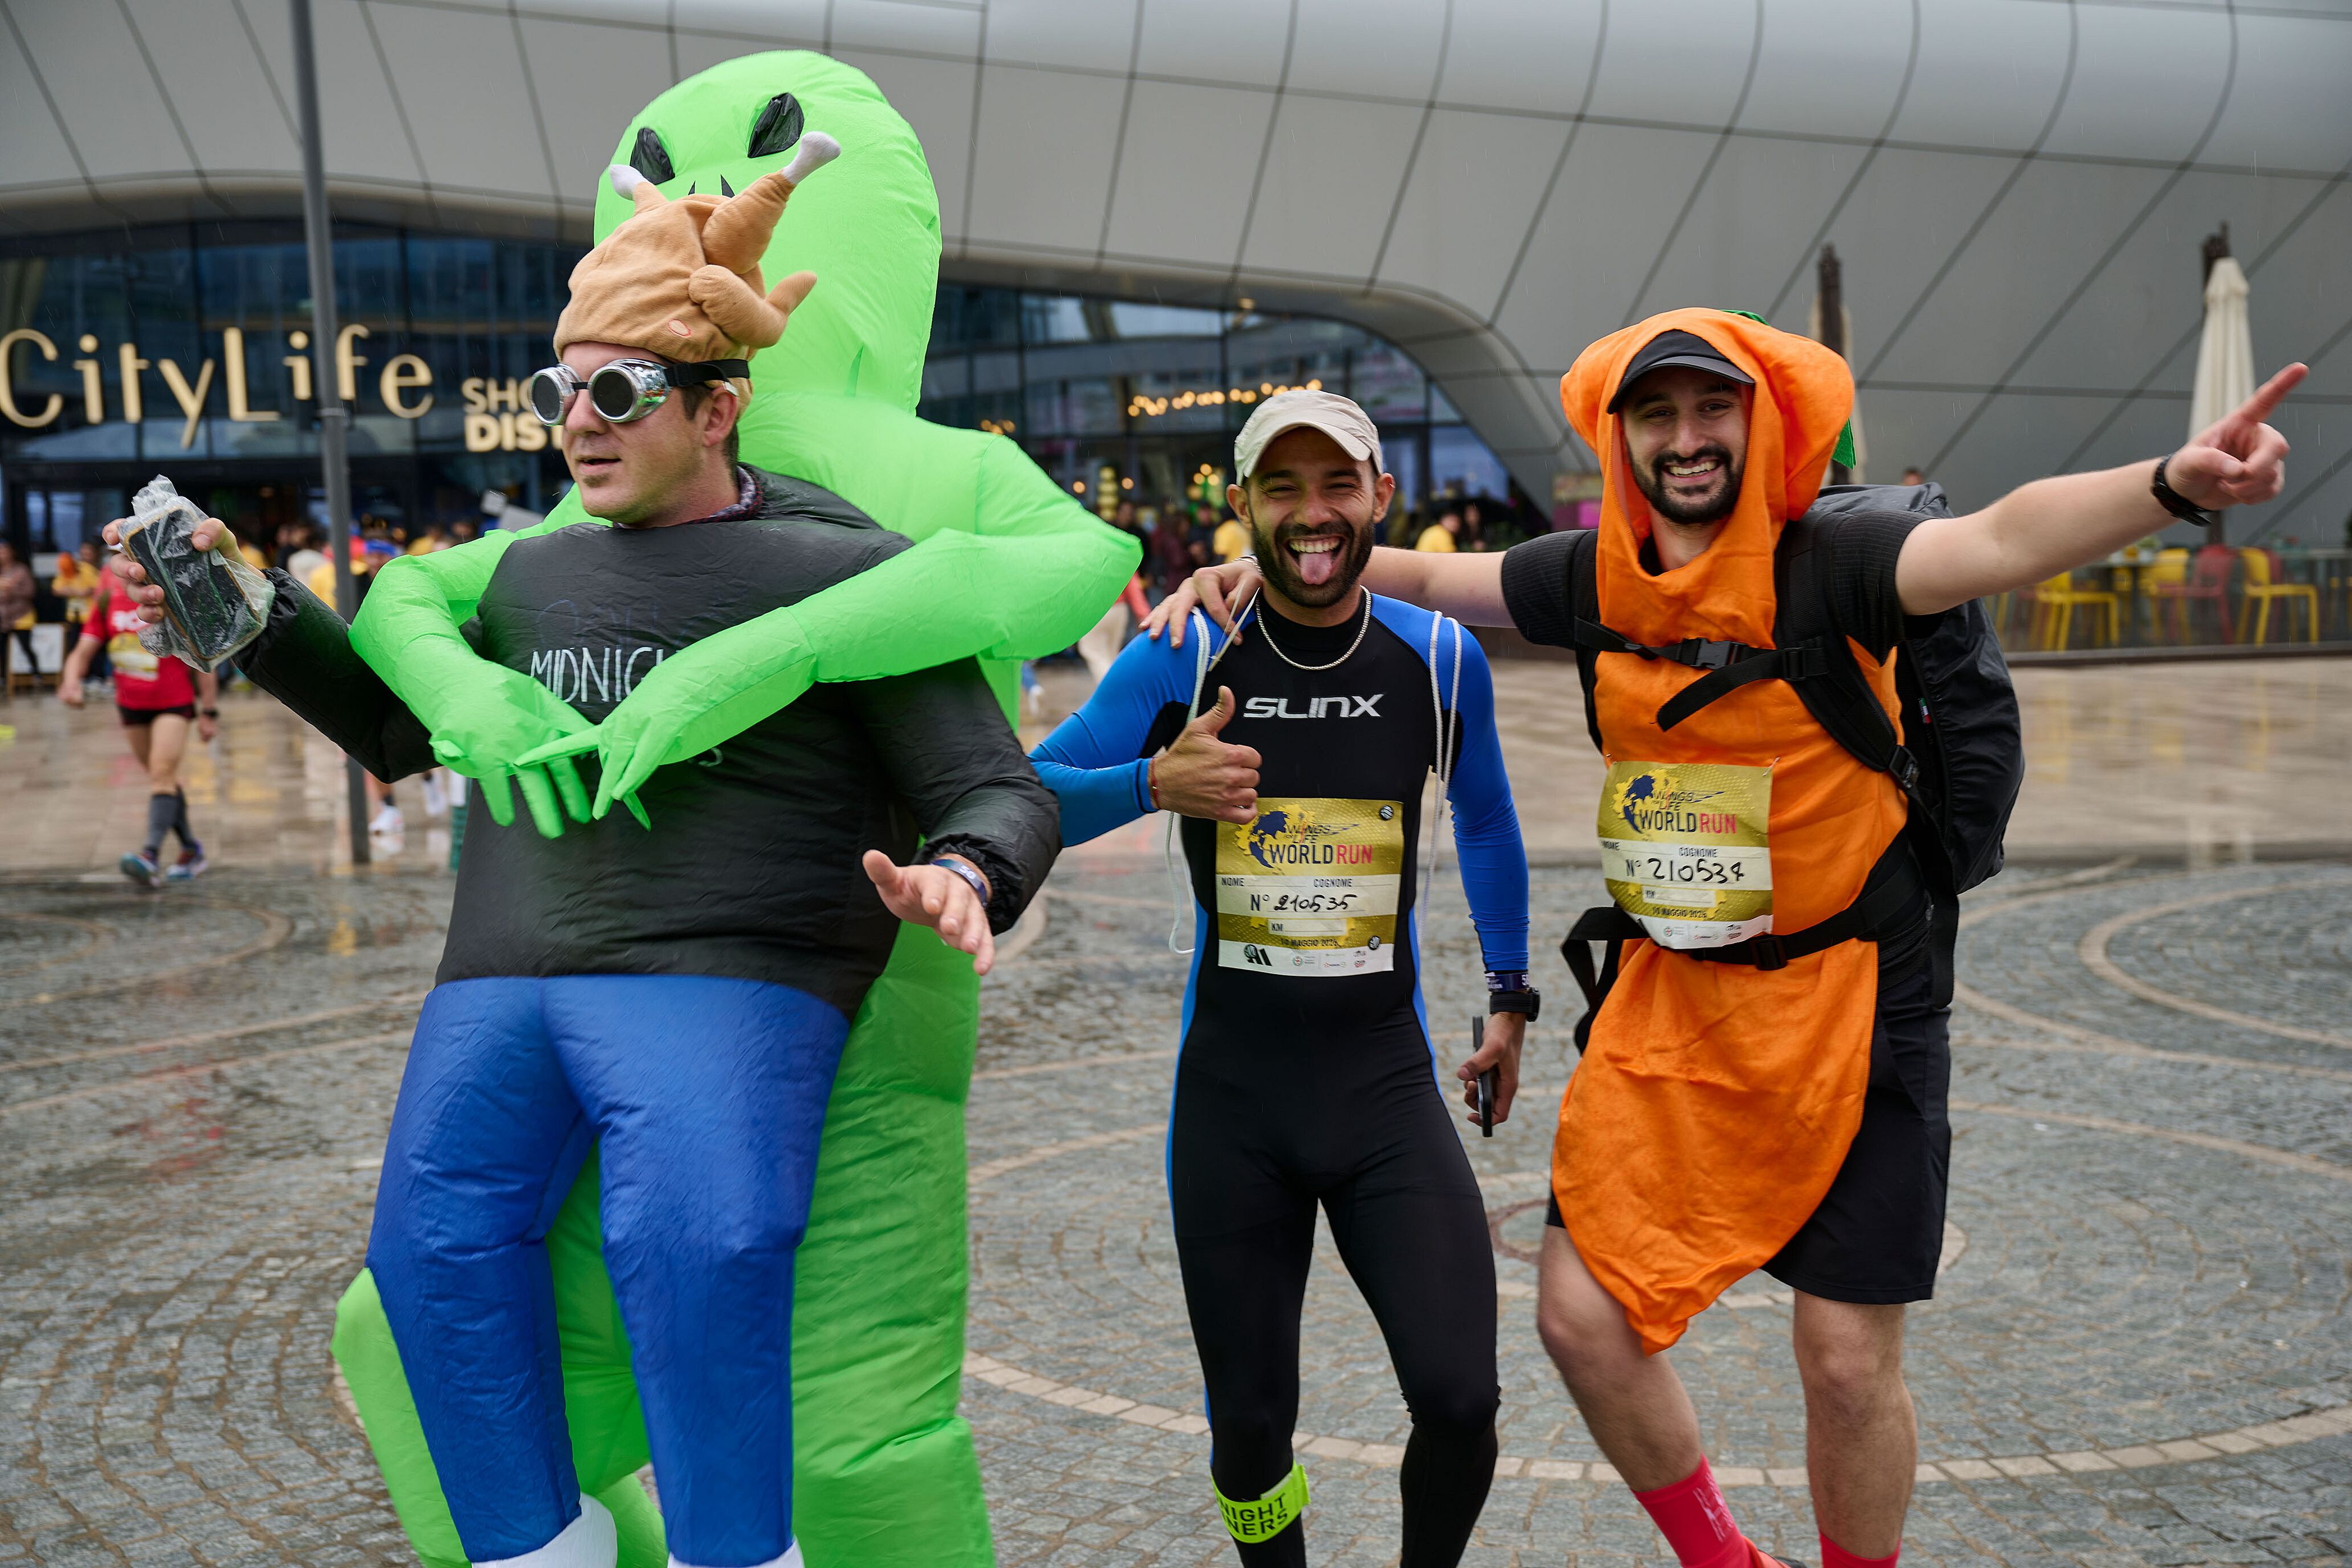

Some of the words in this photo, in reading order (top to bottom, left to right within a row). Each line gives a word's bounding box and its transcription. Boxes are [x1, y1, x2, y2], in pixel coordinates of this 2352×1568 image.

[0, 323, 434, 449] CityLife
[1243, 693, 1385, 719] SLINX
[1639, 809, 1697, 833] WORLD
[1699, 813, 1737, 834] RUN
[1269, 844, 1334, 864] WORLD
[1336, 844, 1373, 865] RUN
[1679, 847, 1718, 858] COGNOME
[1221, 877, 1244, 887] NOME
[1313, 878, 1353, 887] COGNOME
[1648, 857, 1745, 884] 210534
[1274, 894, 1358, 912] 210535
[1217, 1492, 1286, 1522] NIGHT
[1223, 1508, 1288, 1536] NERS
